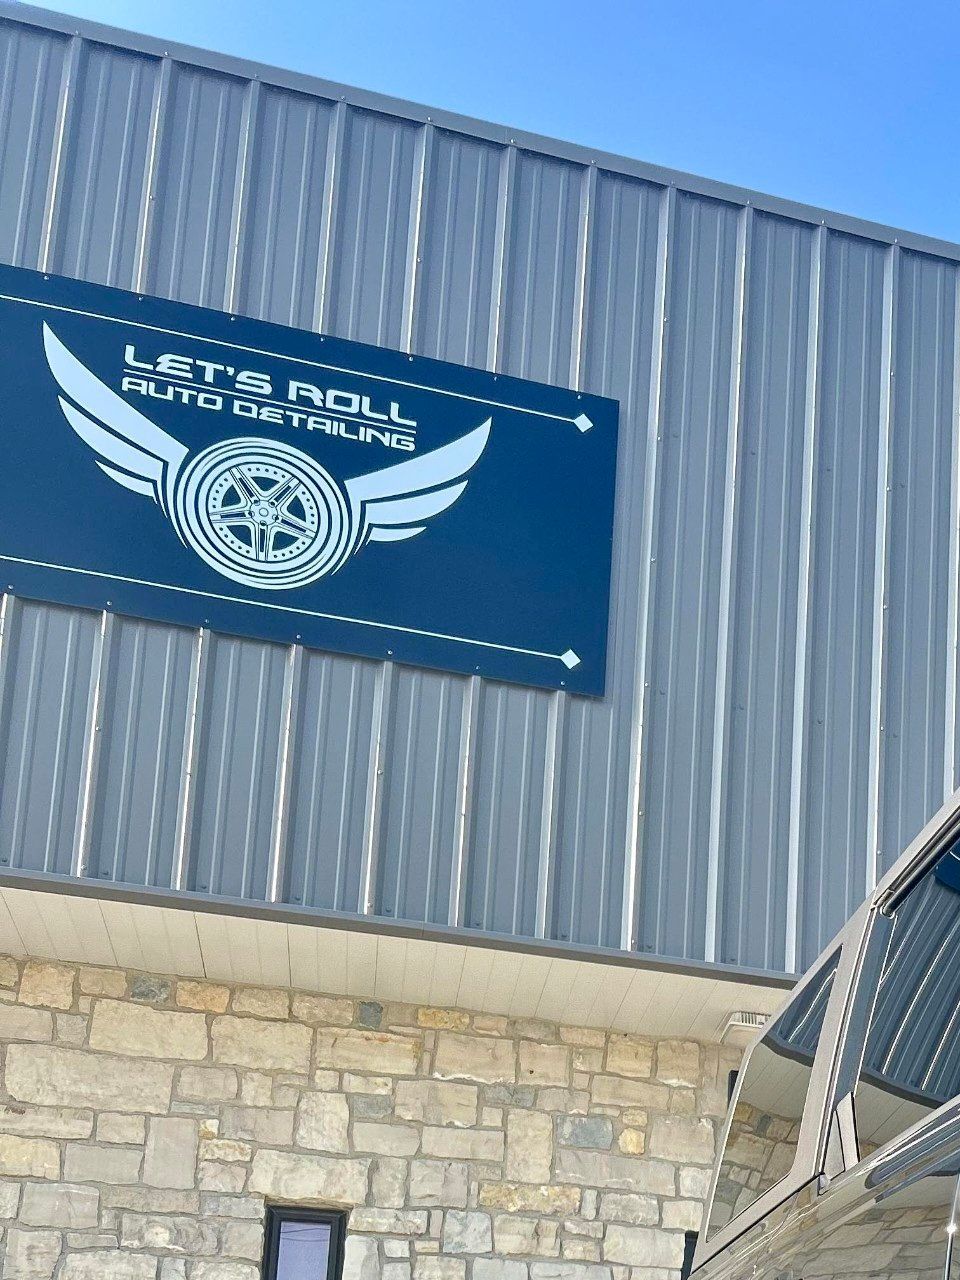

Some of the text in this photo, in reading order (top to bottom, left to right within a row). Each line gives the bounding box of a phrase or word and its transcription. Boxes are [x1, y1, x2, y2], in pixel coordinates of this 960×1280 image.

[121, 377, 416, 452] AUTO DETAILING
[123, 344, 417, 426] LET'S ROLL
